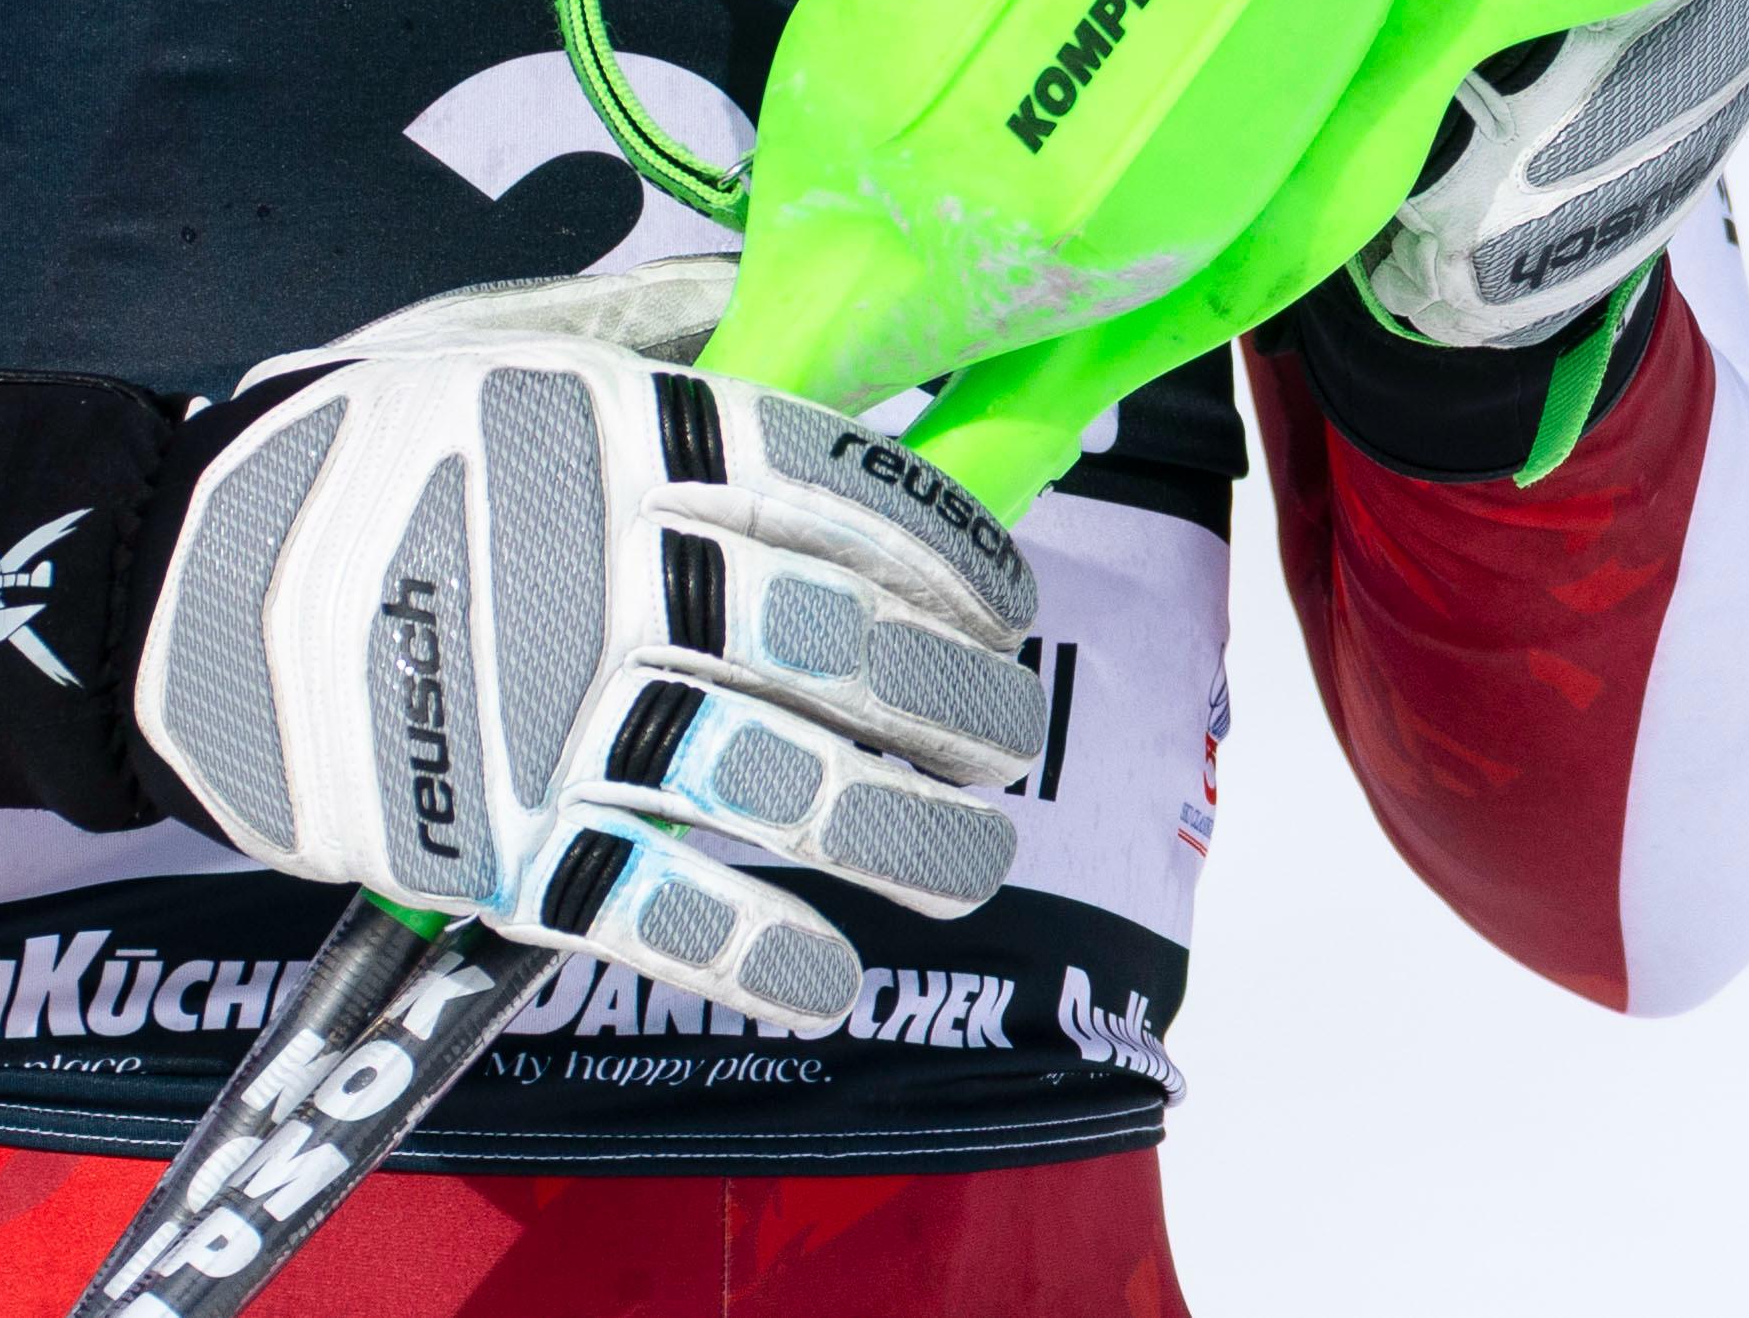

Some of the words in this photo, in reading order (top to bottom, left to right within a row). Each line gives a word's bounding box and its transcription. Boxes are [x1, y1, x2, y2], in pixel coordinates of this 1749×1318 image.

[382, 578, 461, 860] reusch
[485, 1050, 551, 1084] My
[564, 1050, 705, 1087] happy
